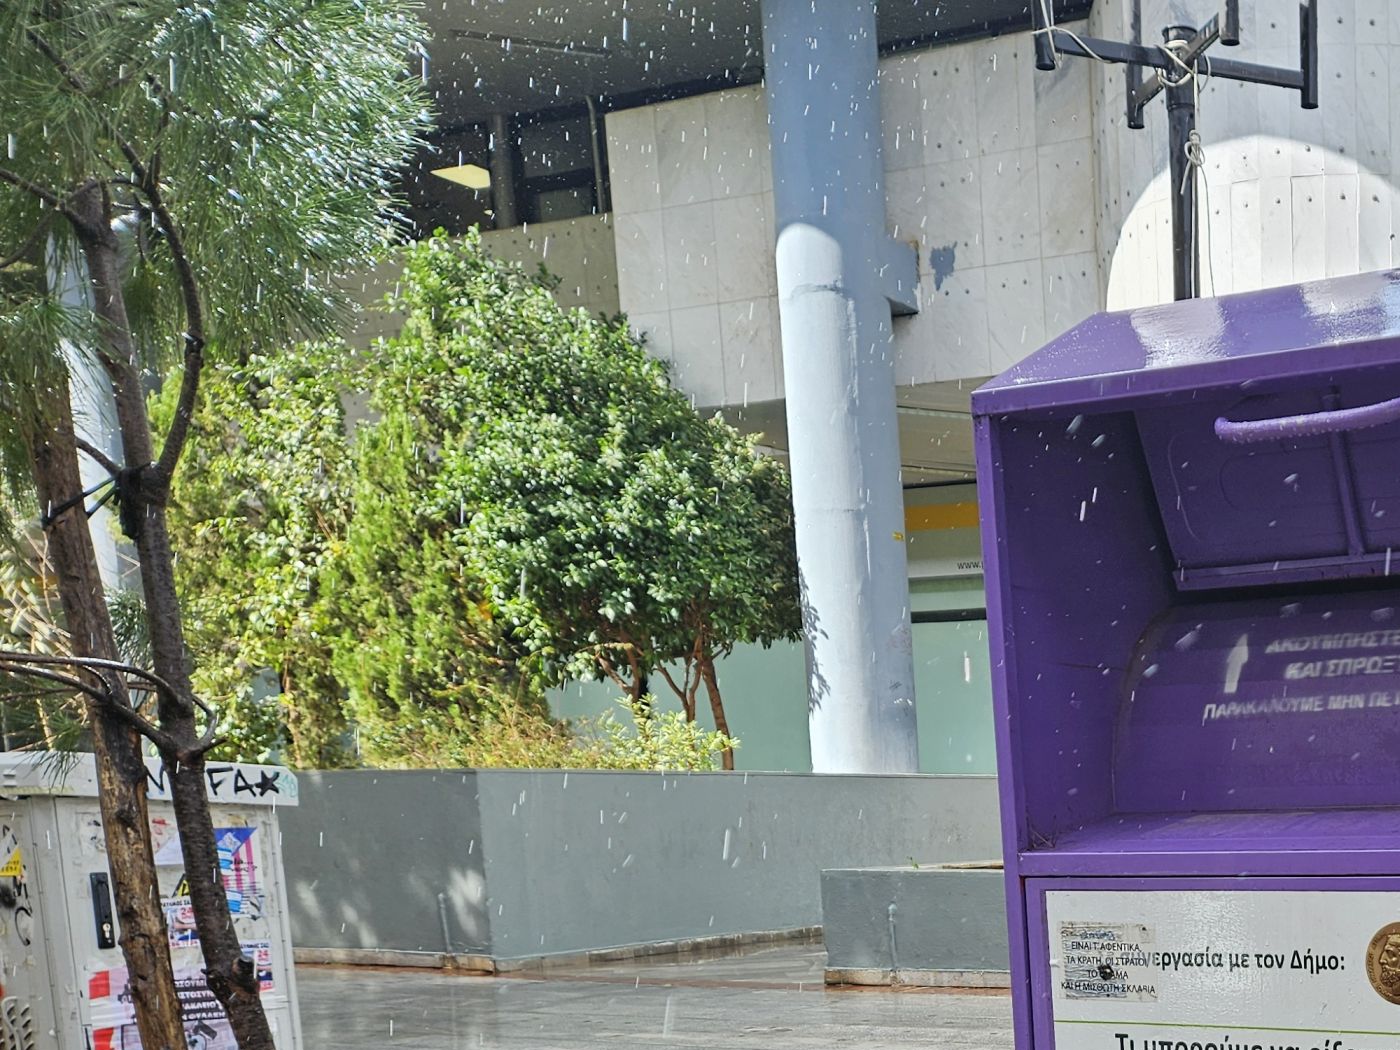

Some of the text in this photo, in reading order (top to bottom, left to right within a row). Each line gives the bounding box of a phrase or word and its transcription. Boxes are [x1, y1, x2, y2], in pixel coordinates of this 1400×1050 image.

[1284, 660, 1321, 680] ΚΑΙ
[1204, 695, 1324, 721] ΠΑΡΑΚΑΛΟΥΜΕ
[1327, 694, 1365, 710] ΜΗΝ
[1071, 941, 1091, 950] ΕΙΝΑΙ
[1066, 956, 1077, 965] ΤΑ
[1229, 951, 1249, 970] με
[1256, 953, 1285, 970] τον
[1290, 947, 1345, 974] Δήμο:
[1087, 970, 1098, 978] ΤΟ
